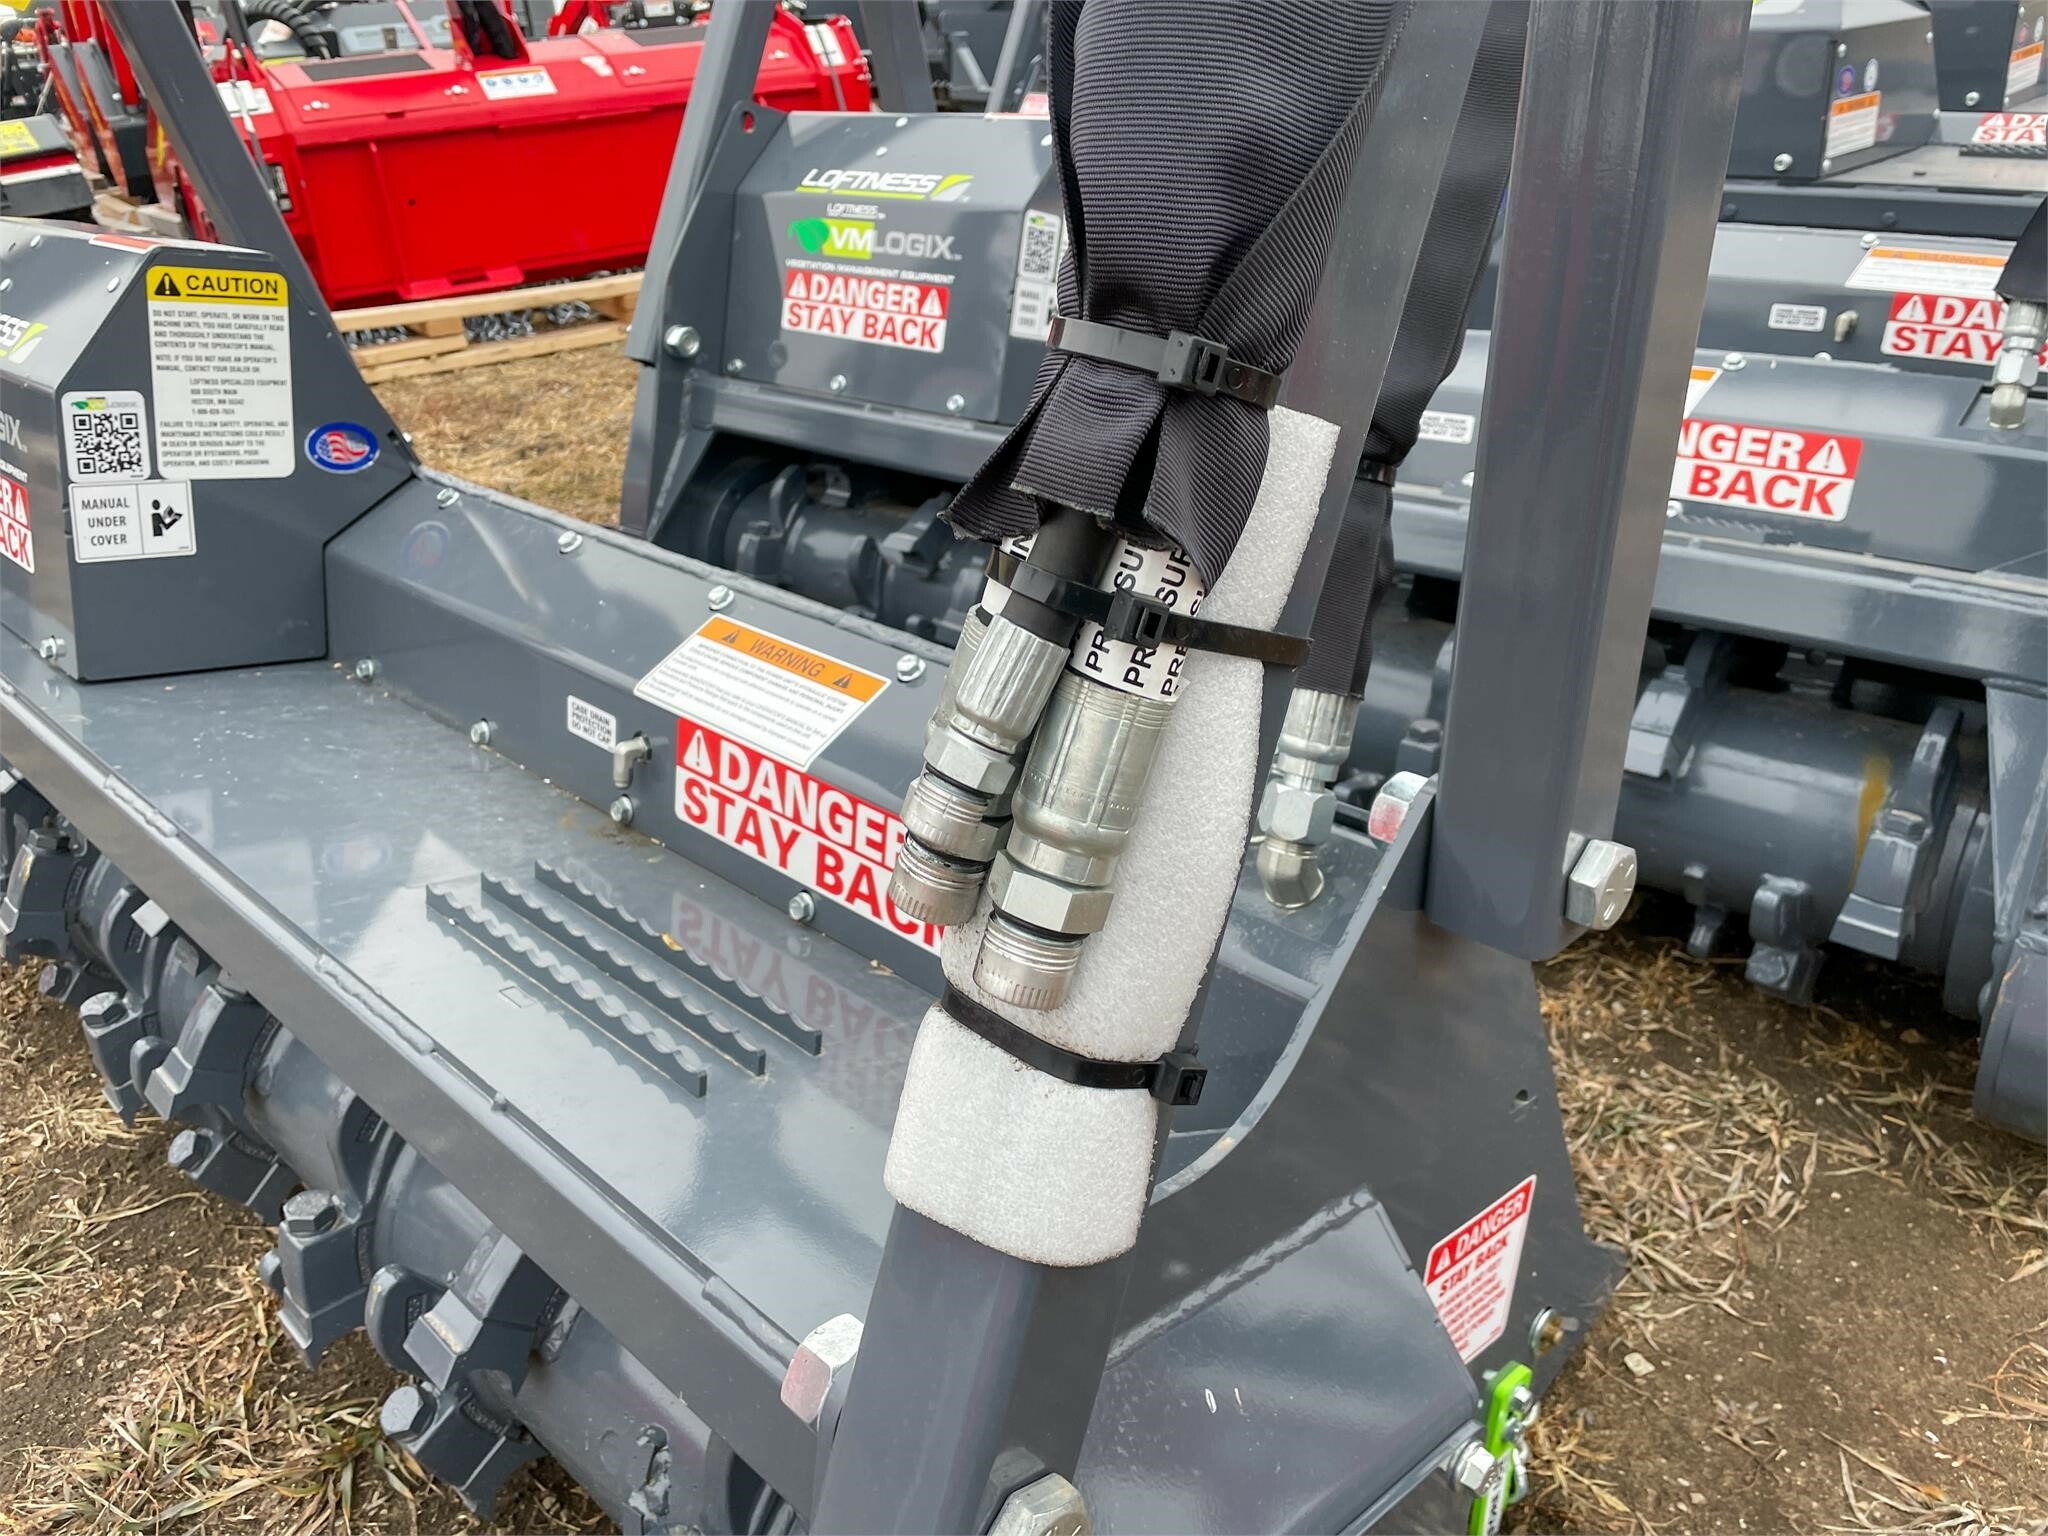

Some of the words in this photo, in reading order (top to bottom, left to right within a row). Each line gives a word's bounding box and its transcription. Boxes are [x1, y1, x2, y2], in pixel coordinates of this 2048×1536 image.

[801, 169, 943, 193] LOFTNESS
[186, 274, 278, 295] CAUTION
[808, 274, 921, 313] DANGER
[788, 303, 856, 334] STAY
[863, 312, 939, 349] BACK
[1892, 327, 2003, 361] STAY
[81, 497, 130, 510] MANUAL
[1688, 464, 1841, 516] BACK
[88, 516, 127, 529] UNDER
[90, 534, 128, 546] COVER
[749, 639, 825, 677] WARNING
[684, 778, 802, 870] STAY
[815, 841, 945, 948] BAC
[1454, 1191, 1526, 1261] DANGER
[1439, 1259, 1474, 1298] STAY
[1474, 1231, 1511, 1270] BACK
